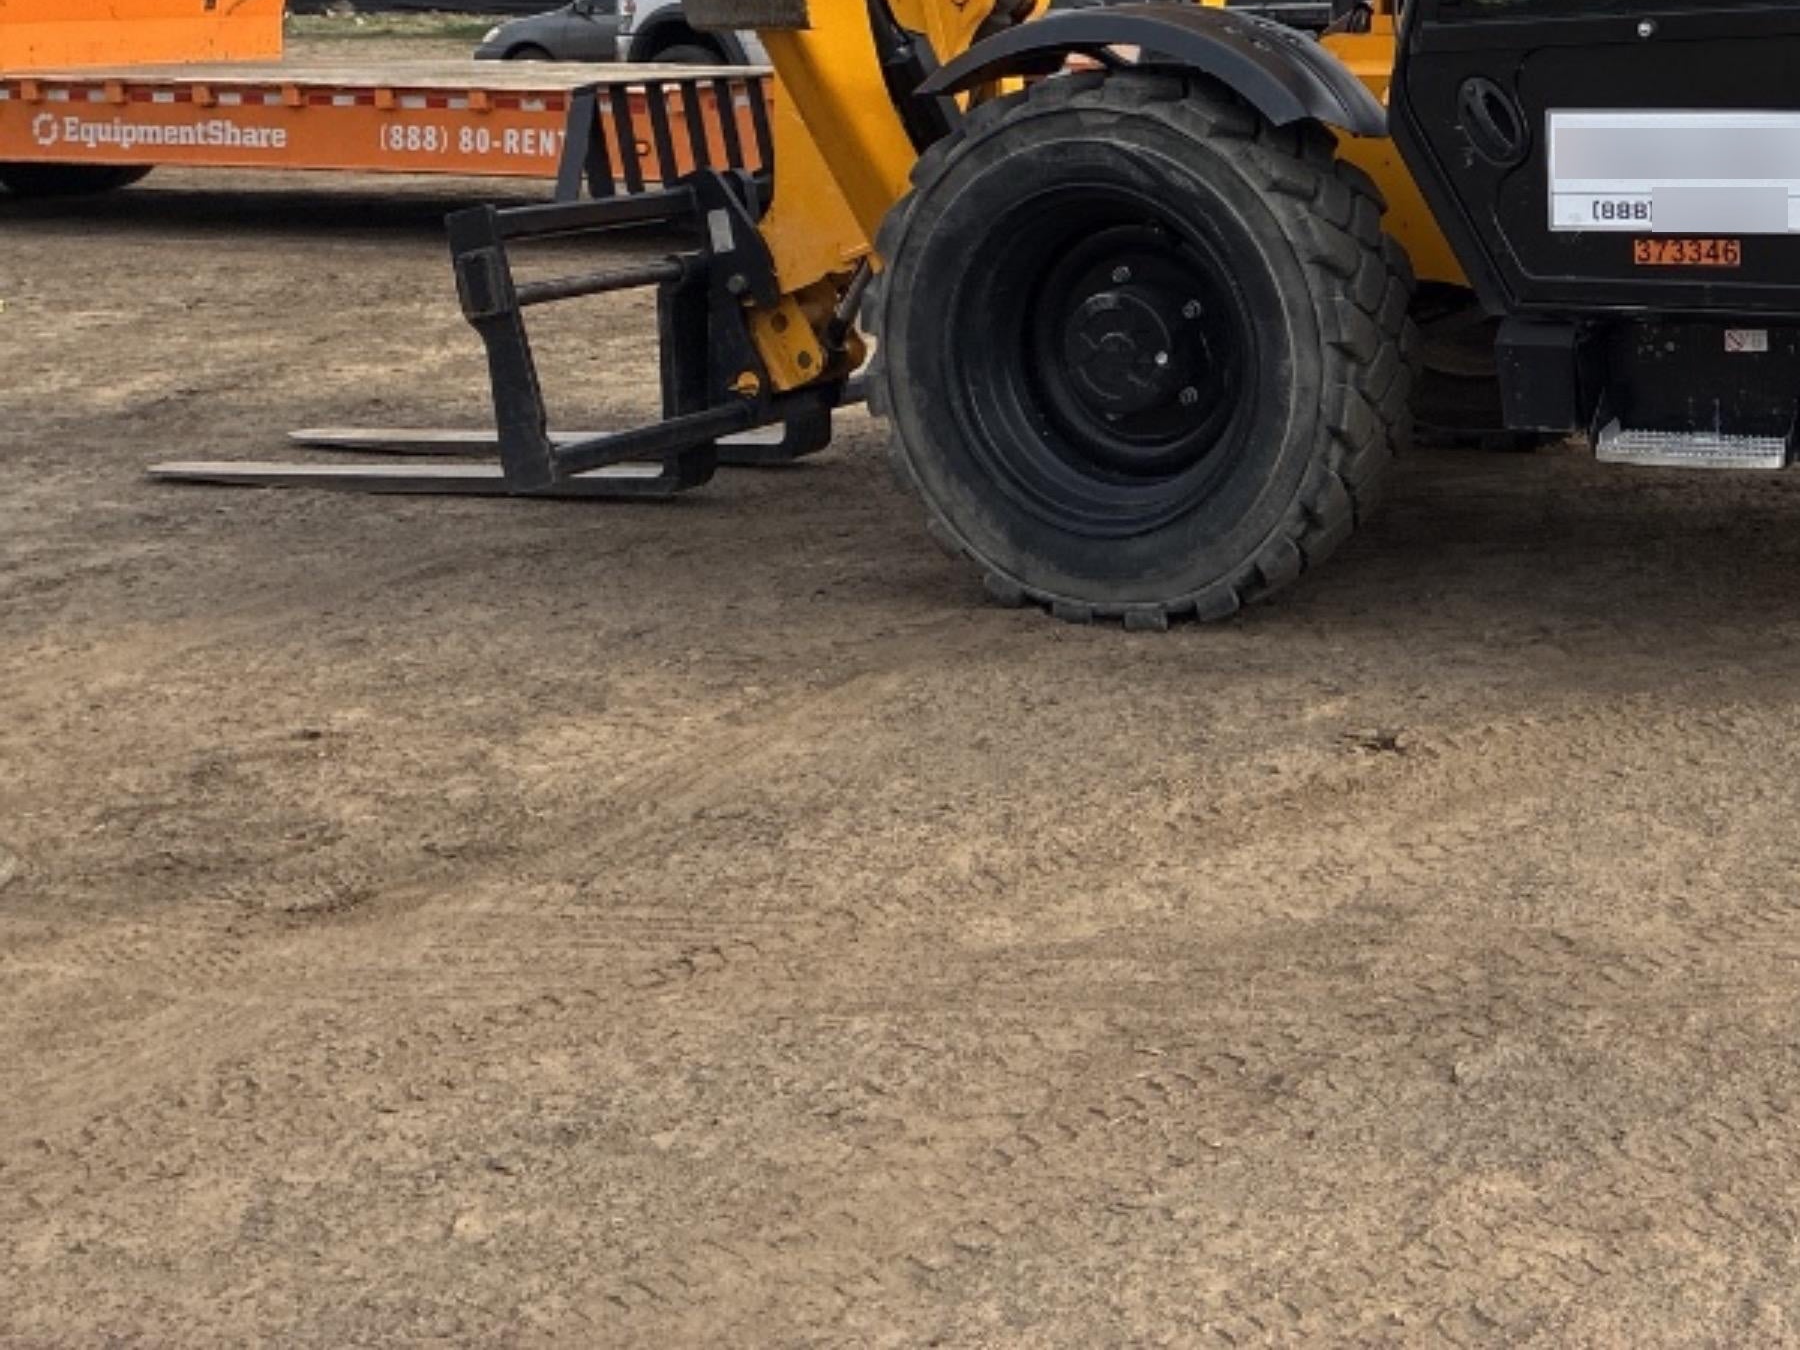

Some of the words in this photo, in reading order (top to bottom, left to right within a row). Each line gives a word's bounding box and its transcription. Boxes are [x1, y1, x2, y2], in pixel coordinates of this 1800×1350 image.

[62, 115, 288, 149] EquipmentShare
[379, 122, 449, 154] (888)
[1636, 241, 1739, 263] 373346
